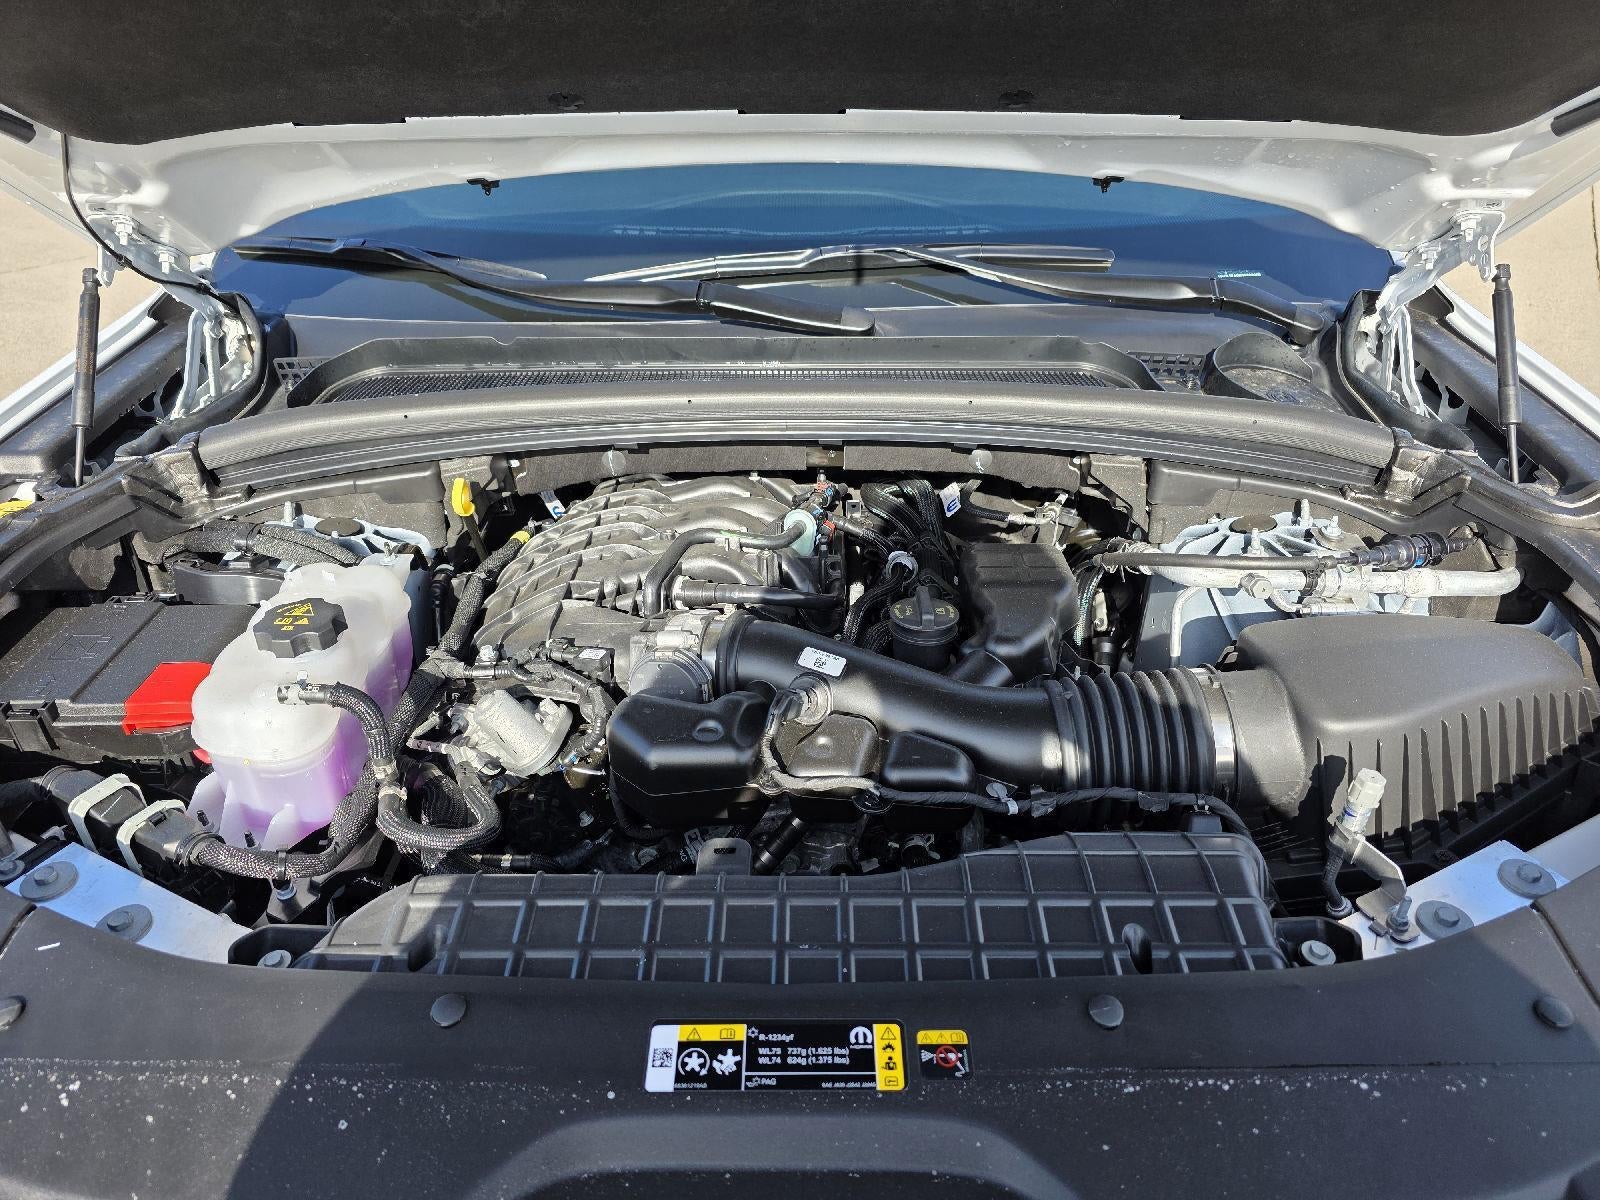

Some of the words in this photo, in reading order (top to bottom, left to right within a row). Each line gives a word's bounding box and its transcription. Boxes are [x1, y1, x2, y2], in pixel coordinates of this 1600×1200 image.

[758, 1033, 794, 1042] R-1234yf
[787, 1047, 807, 1056] 737g
[808, 1056, 833, 1066] (1.375
